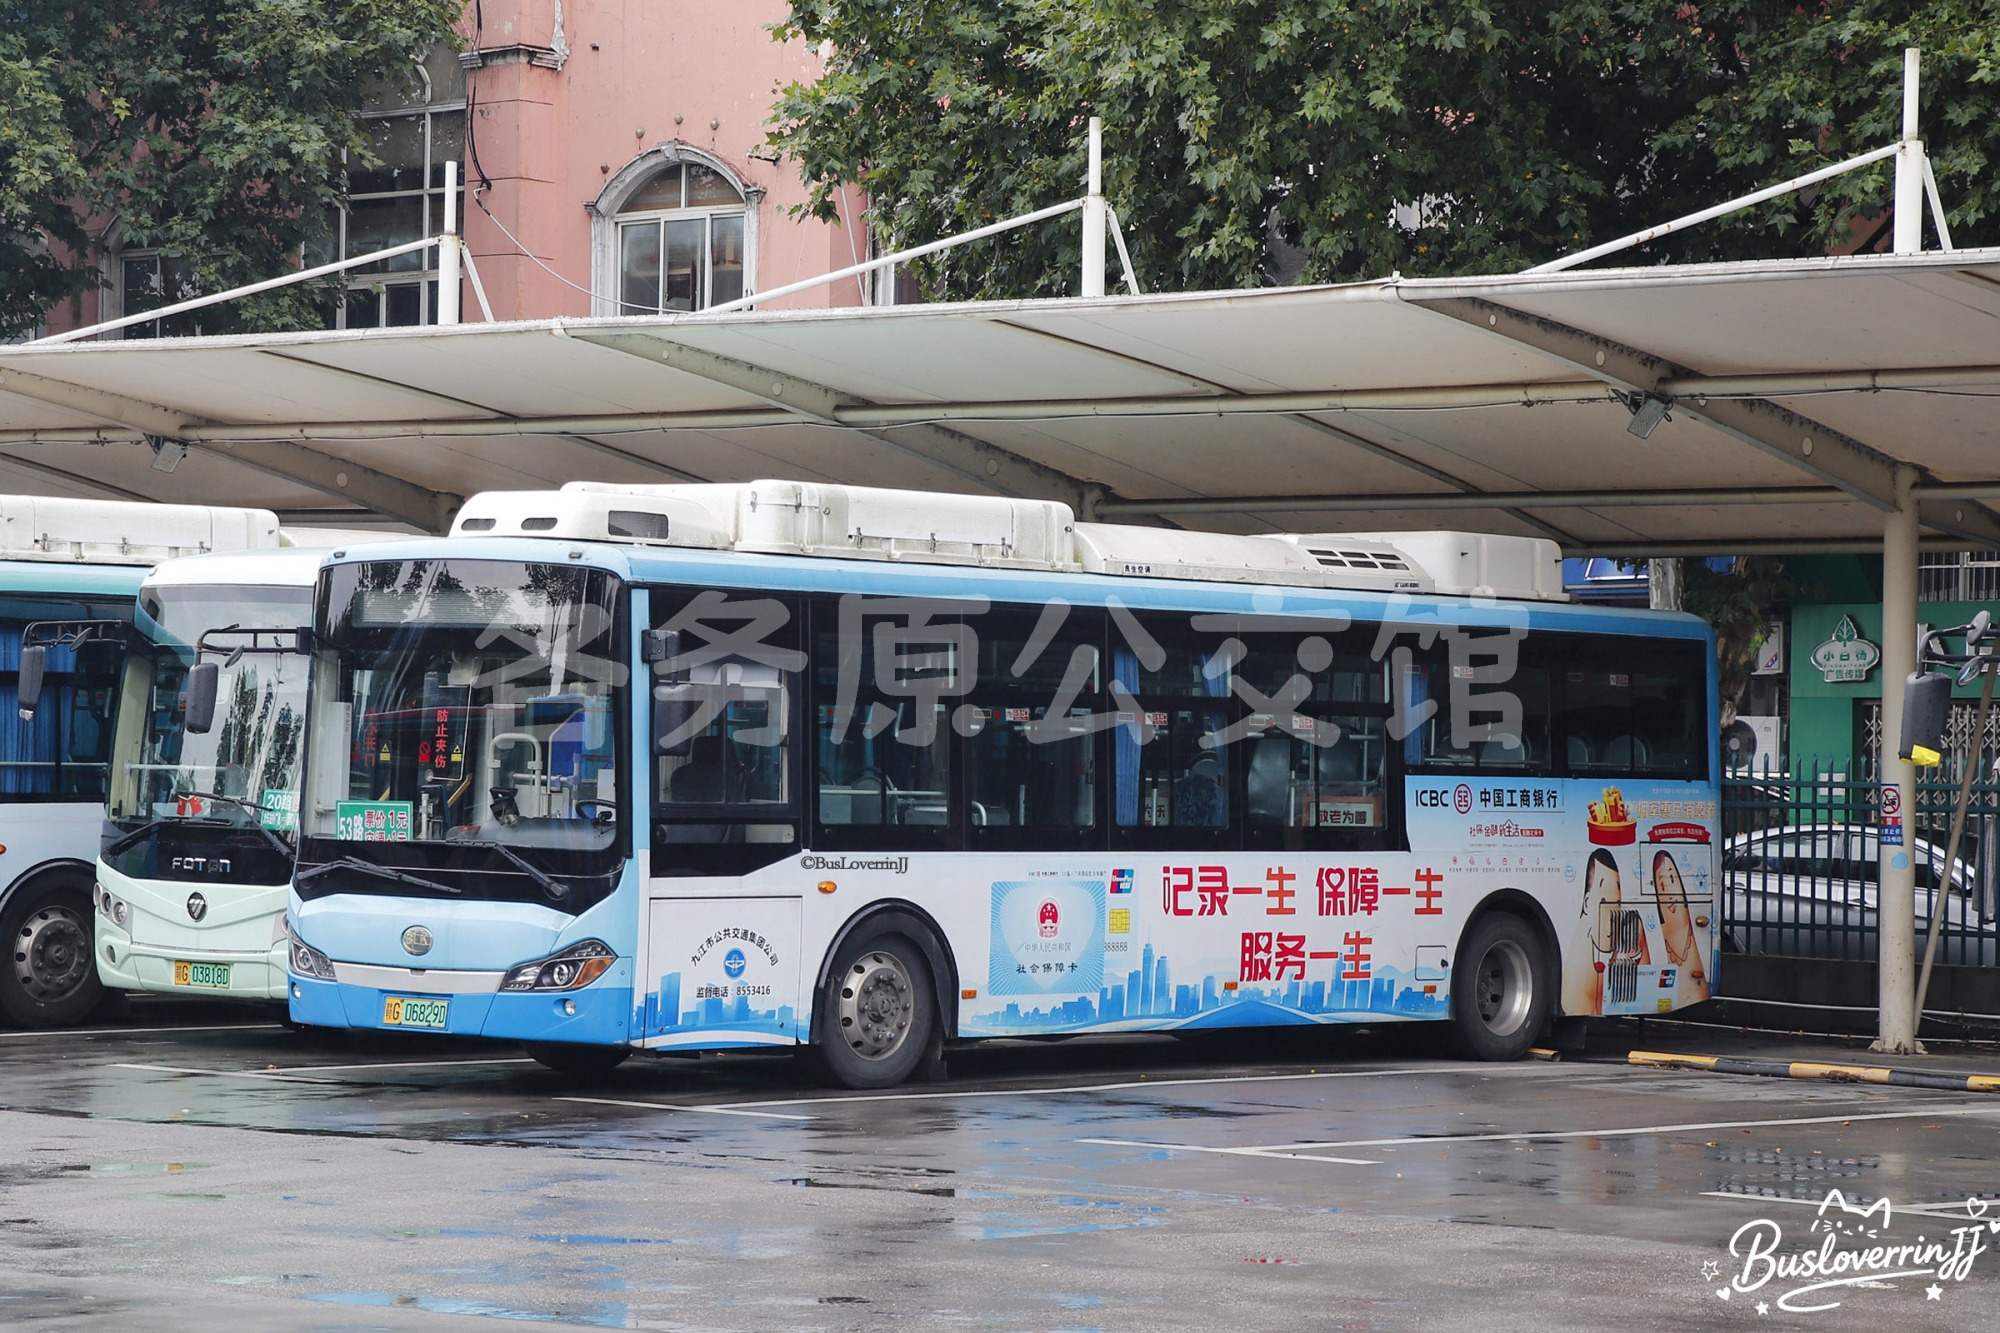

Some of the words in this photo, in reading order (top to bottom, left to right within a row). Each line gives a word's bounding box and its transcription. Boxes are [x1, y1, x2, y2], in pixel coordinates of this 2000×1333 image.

[434, 709, 449, 768] 防止夹伤
[1415, 789, 1449, 807] ICBC
[1479, 787, 1558, 809] 中国工商银行
[1162, 865, 1296, 917] 记录一生
[1316, 866, 1443, 917] 保障一生
[690, 927, 779, 967] 九江市公共交通集团公司
[1024, 941, 1072, 954] 中华人民共和国
[1239, 931, 1373, 982] 服务一生
[1016, 962, 1078, 974] 社会保障卡
